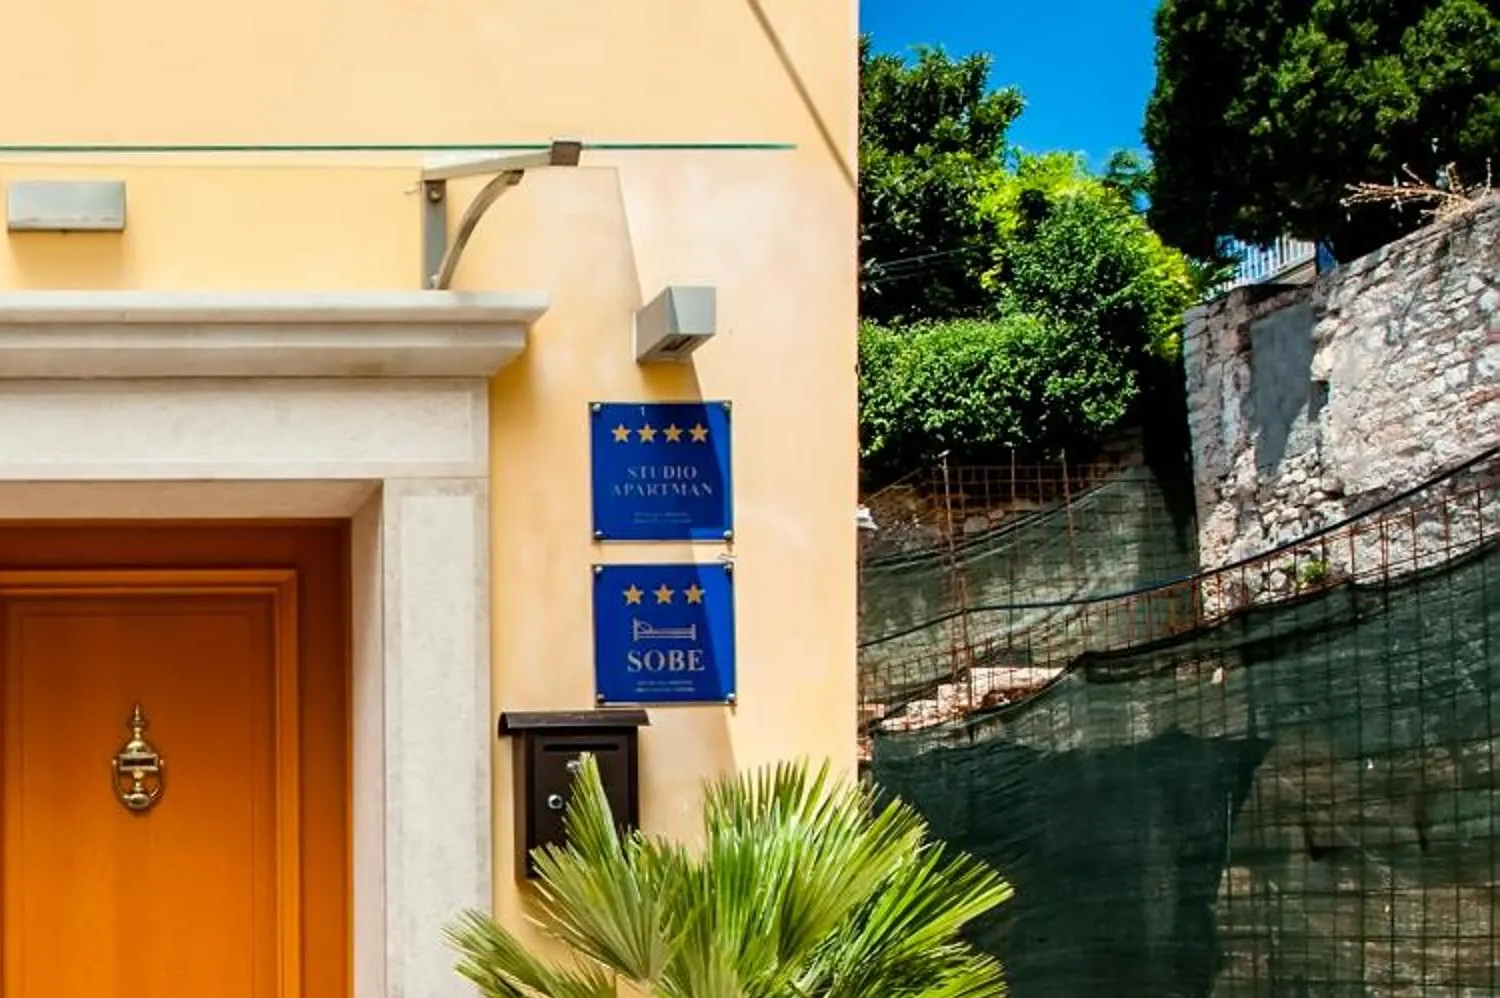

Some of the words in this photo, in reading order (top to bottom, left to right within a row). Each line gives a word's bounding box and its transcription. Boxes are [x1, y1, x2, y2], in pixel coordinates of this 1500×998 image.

[627, 465, 698, 480] STUDIO
[612, 482, 713, 497] APARTMAN
[627, 649, 706, 673] SOBE
